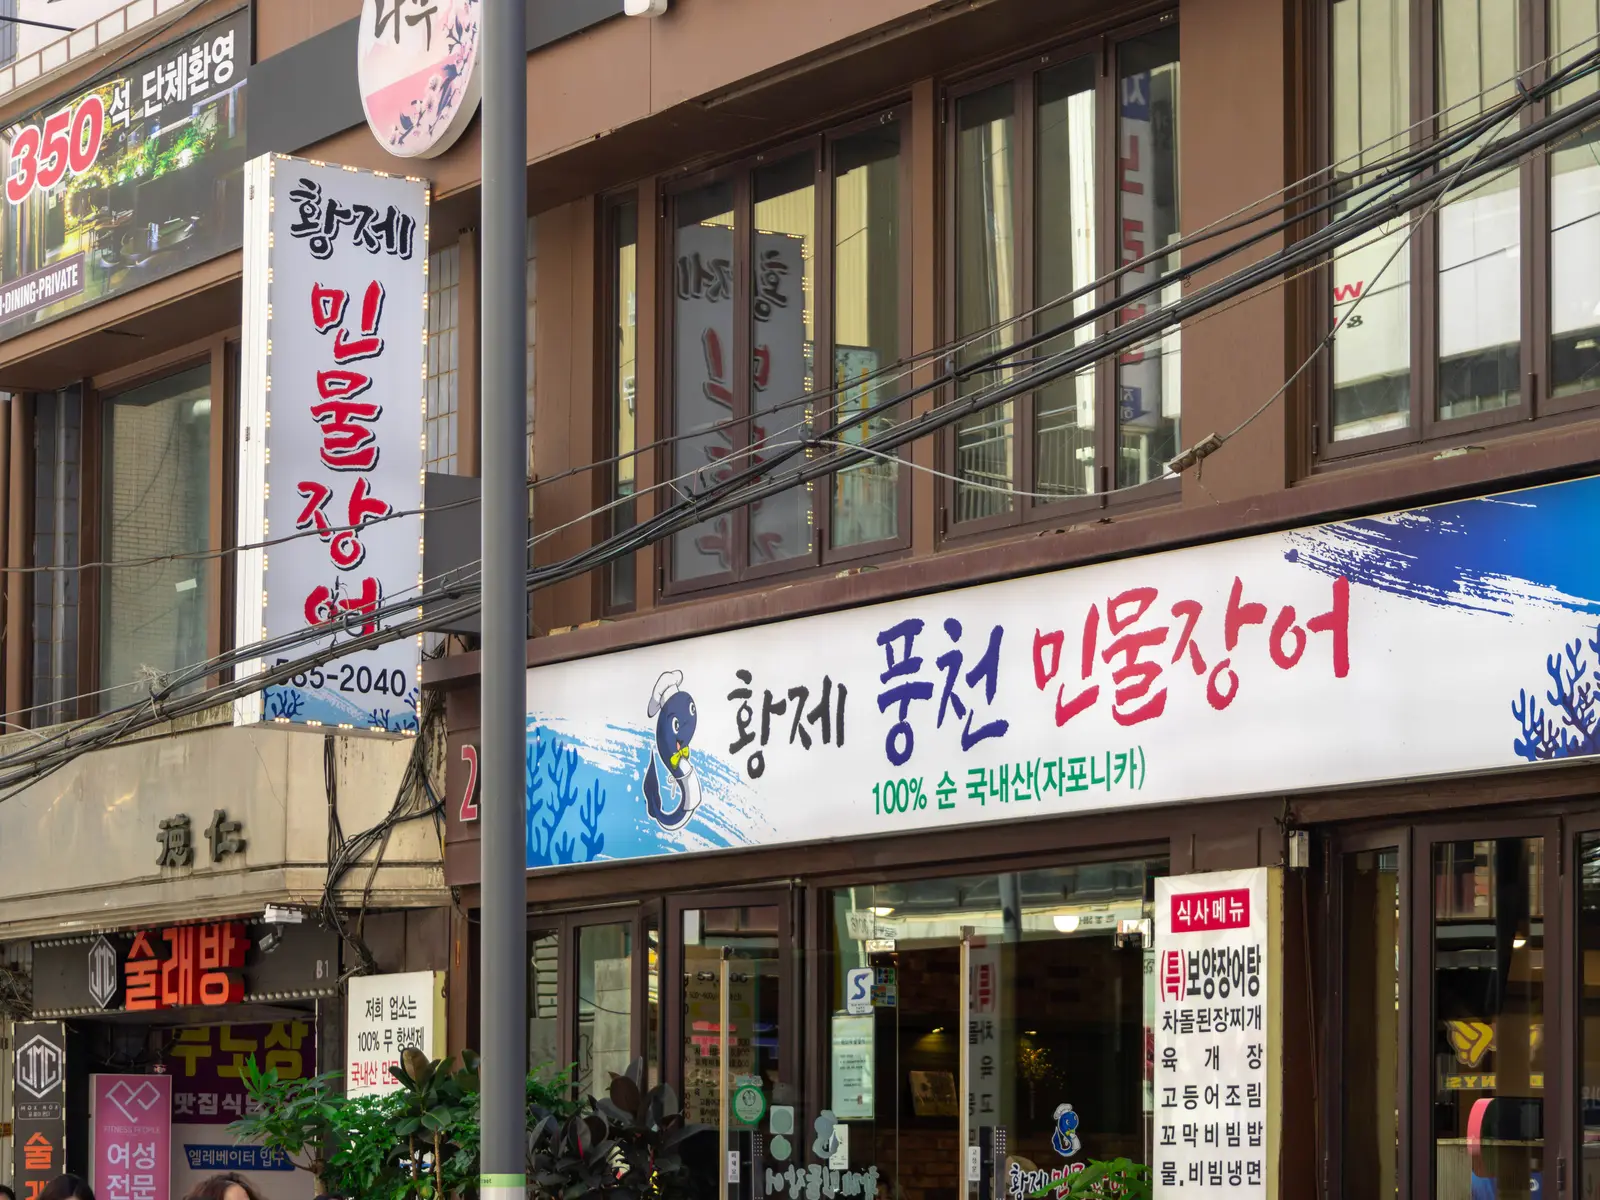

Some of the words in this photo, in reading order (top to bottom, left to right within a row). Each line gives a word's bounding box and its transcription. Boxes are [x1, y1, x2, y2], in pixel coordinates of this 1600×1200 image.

[5, 94, 104, 205] 350
[109, 80, 131, 128] 석
[142, 29, 235, 118] 단체환영
[289, 177, 415, 260] 황제
[295, 279, 393, 650] 민물장어
[727, 668, 848, 779] 황제
[876, 617, 1010, 767] 풍천
[1032, 575, 1351, 728] 민물장어
[872, 776, 928, 815] 100%
[935, 771, 957, 809] 순
[965, 745, 1146, 806] 국내산(자포니카)
[1176, 896, 1244, 926] 식사메뉴
[124, 921, 249, 1011] 술래방
[316, 959, 330, 979] B1
[1160, 944, 1262, 1002] (특)보양장어탕
[365, 997, 384, 1021] 저희
[389, 995, 417, 1021] 업소는
[1162, 1005, 1262, 1035] 차돌된장찌개
[357, 1030, 380, 1052] 100%
[383, 1028, 393, 1053] 무
[396, 1026, 425, 1051] 항생제
[351, 1060, 378, 1086] 국내산
[1161, 1083, 1262, 1110] 고등어조림
[1160, 1121, 1263, 1148] 꼬막비빔밥
[107, 1142, 155, 1170] 여성
[188, 1149, 256, 1166] 엘레베이터
[106, 1173, 156, 1200] 전문
[1161, 1159, 1262, 1187] 물.비빔냉면
